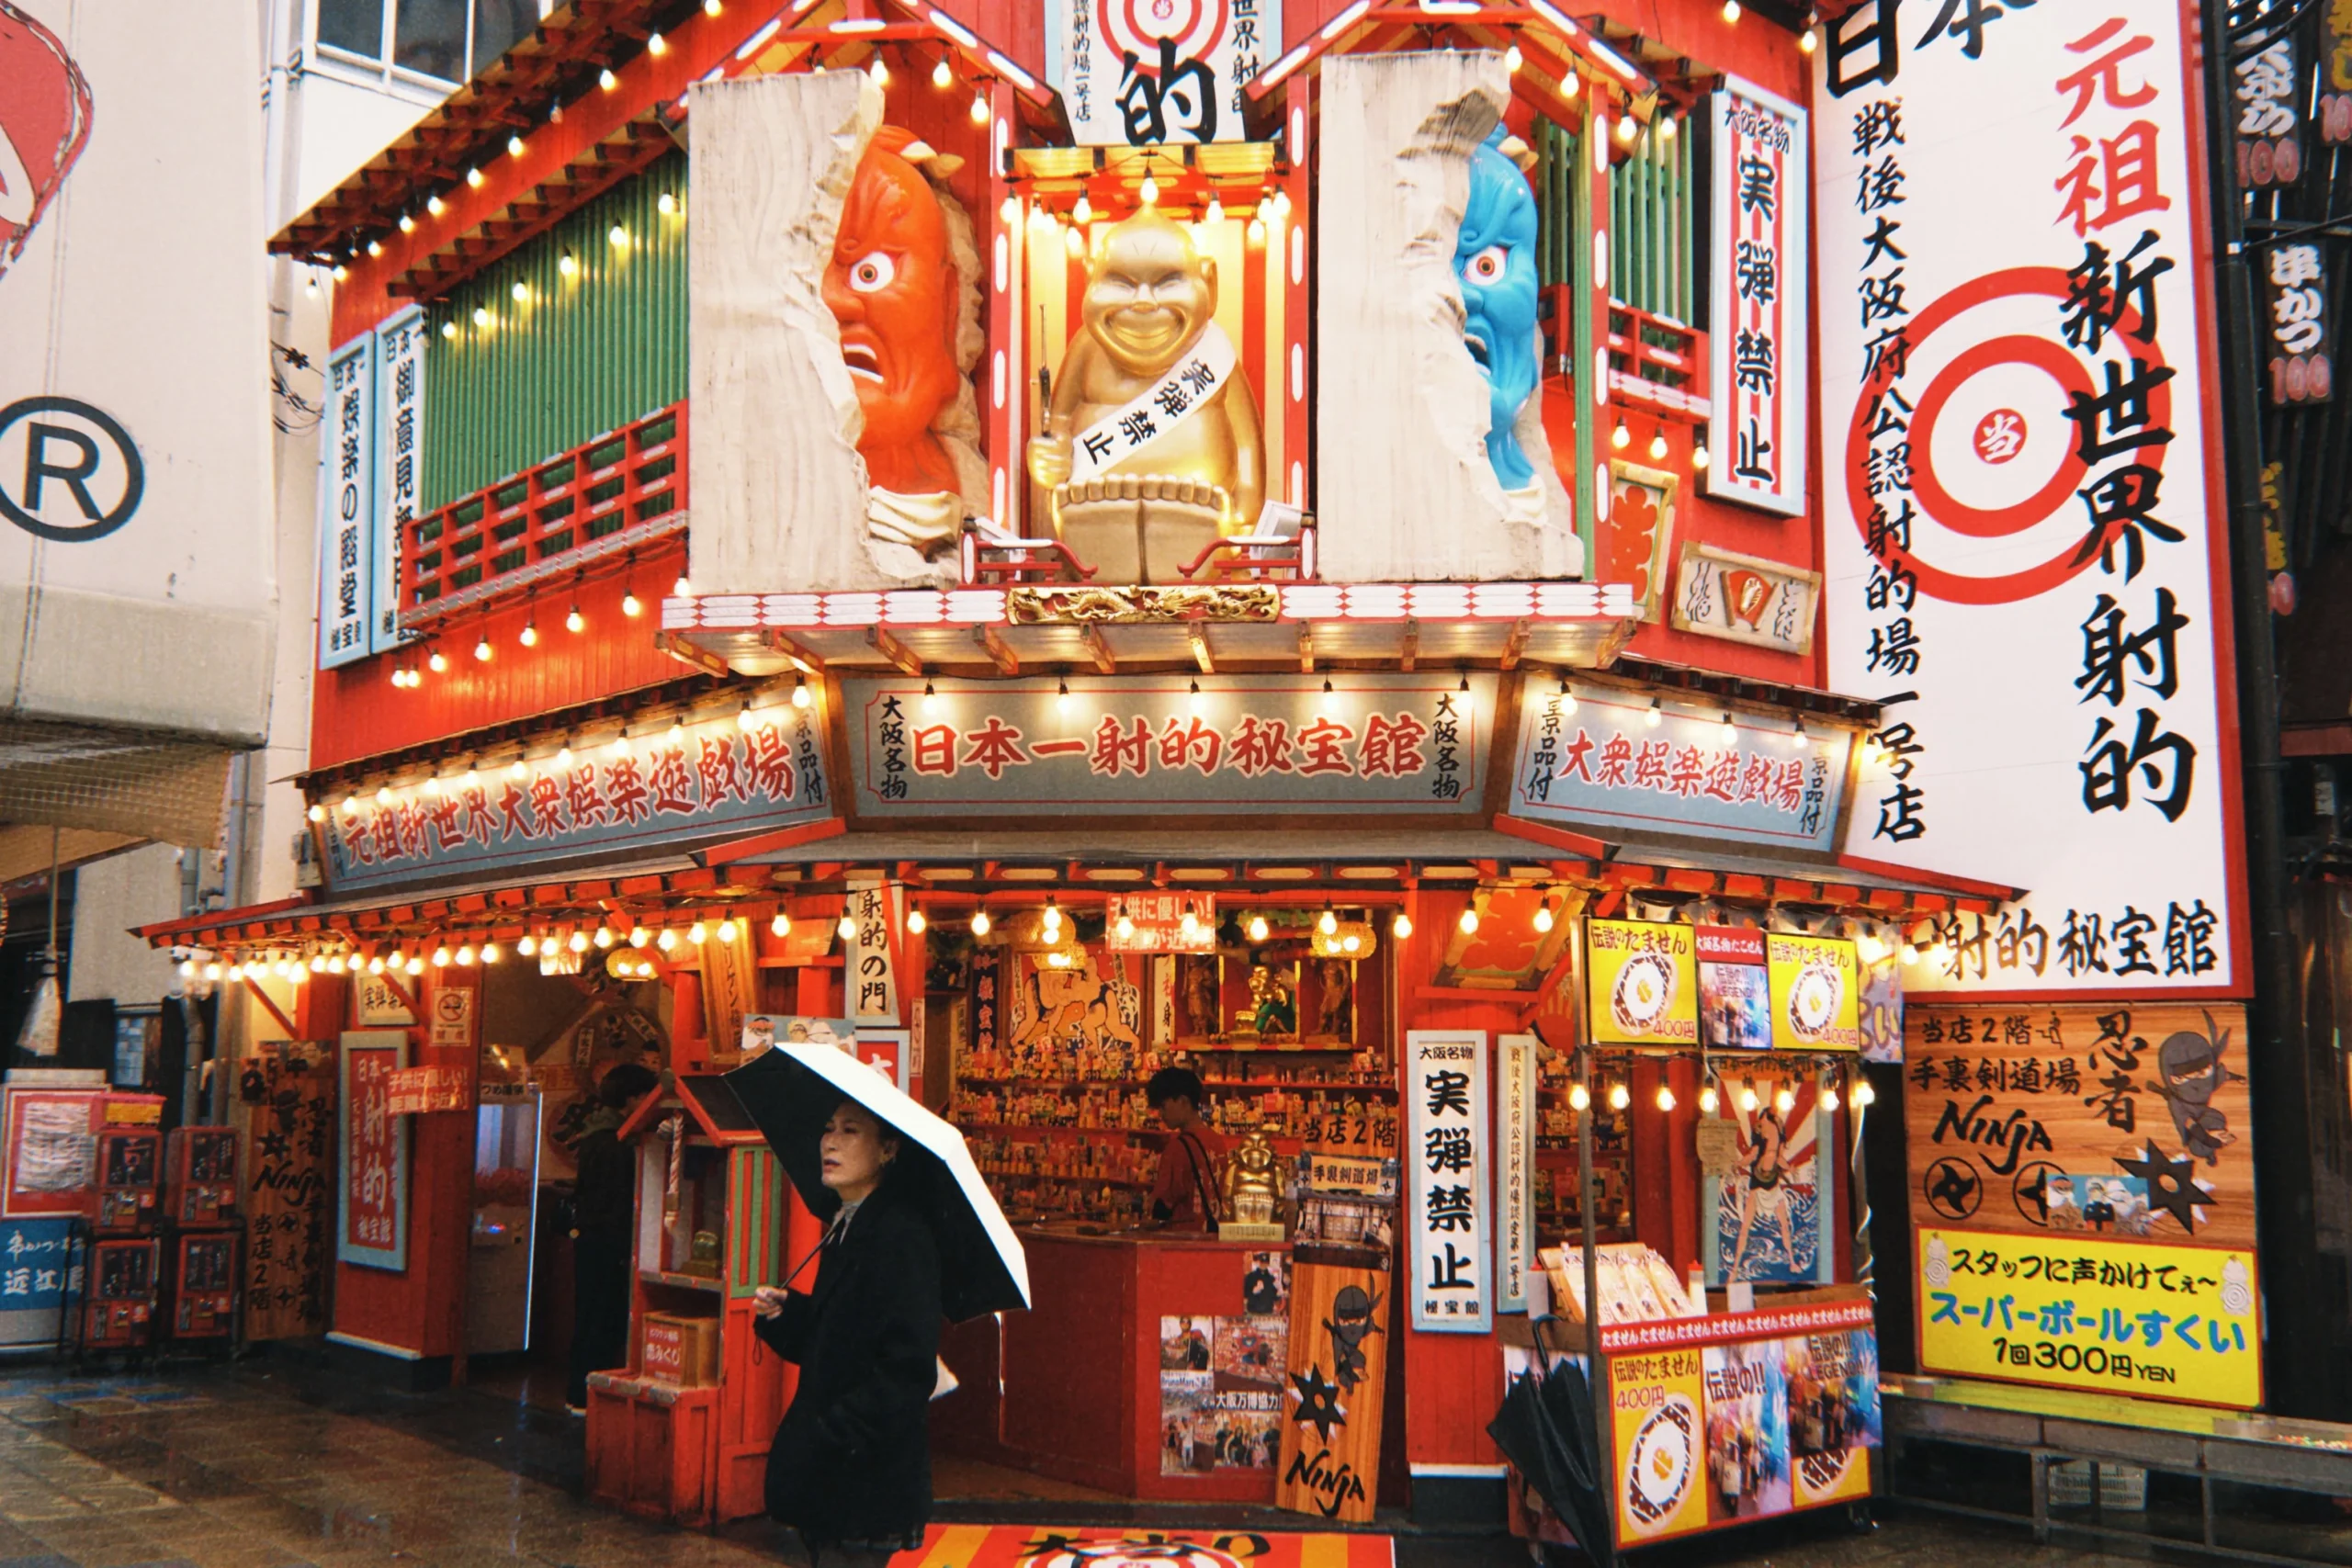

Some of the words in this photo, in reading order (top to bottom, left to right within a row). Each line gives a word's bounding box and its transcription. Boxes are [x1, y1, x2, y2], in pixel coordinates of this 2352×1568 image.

[1115, 36, 1217, 145] 的
[1724, 106, 1790, 154] 大阪名物
[2236, 138, 2300, 186] 100
[1736, 154, 1776, 484] 実弾禁止
[2271, 244, 2323, 355] 串かつ
[2269, 354, 2330, 404] 100
[1083, 358, 1216, 465] 実弾禁止
[1980, 412, 2018, 459] 当
[1851, 96, 1927, 843] 戦後大阪府公認射的場一号店
[880, 695, 907, 799] 大阪名物
[910, 714, 1428, 779] 日本一射的秘宝館
[1432, 693, 1460, 799] 大阪名物
[1556, 728, 1806, 812] 大衆娯楽遊戯場
[343, 723, 796, 867] 元祖新世界大衆娯楽遊戯場
[860, 889, 888, 1011] 射的の門
[1591, 925, 1688, 954] 伝説のたません
[1770, 940, 1850, 969] 伝説のたません
[1419, 1046, 1474, 1060] 大阪名物
[1654, 1020, 1695, 1040] 400円
[1822, 1028, 1859, 1046] 400円
[1921, 1015, 2032, 1045] 当店2階
[357, 1056, 393, 1083] 日本一
[1910, 1056, 2082, 1095] 手裏剣道場
[2084, 1010, 2148, 1134] 忍者
[1305, 1118, 1396, 1147] 当店2階
[1314, 1165, 1378, 1185] 手裏剣道場
[1425, 1070, 1475, 1291] 実弾禁止
[1425, 1300, 1479, 1314] 秘宝館
[1602, 1328, 1638, 1347] たません
[1640, 1325, 1676, 1343] たません
[1677, 1321, 1713, 1339] たません
[1713, 1318, 1746, 1336] たません
[1746, 1314, 1779, 1333] たません
[1780, 1311, 1812, 1328] たません
[1812, 1308, 1842, 1325] たません
[1843, 1304, 1872, 1322] たません
[1931, 1291, 2246, 1353] スーパーボールすくい
[1614, 1352, 1699, 1382] 伝説のたません
[1706, 1360, 1767, 1404] 伝説の!!
[1616, 1384, 1665, 1409] 400円
